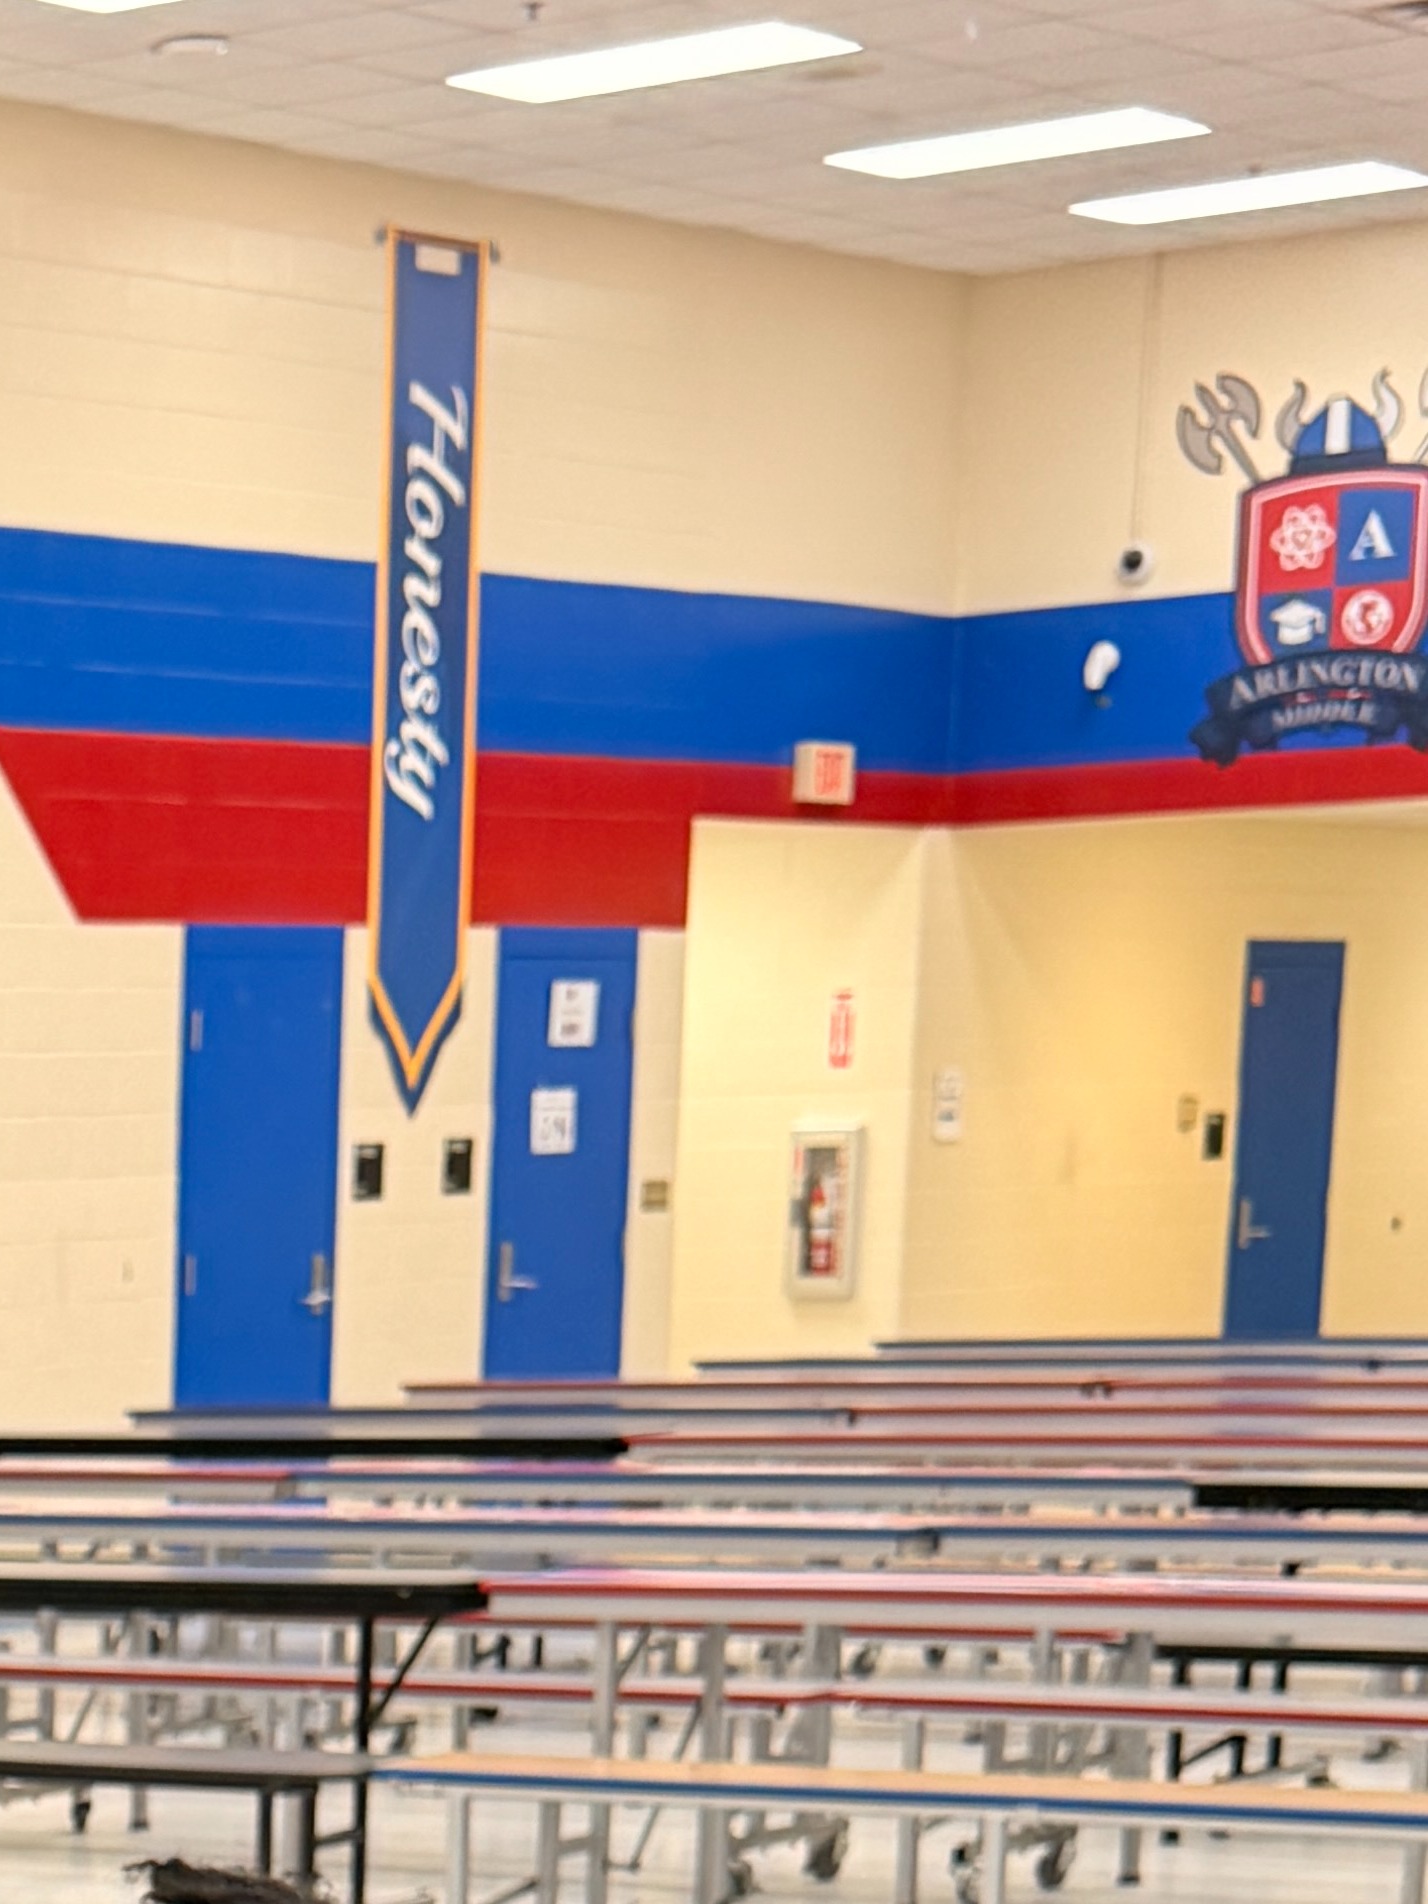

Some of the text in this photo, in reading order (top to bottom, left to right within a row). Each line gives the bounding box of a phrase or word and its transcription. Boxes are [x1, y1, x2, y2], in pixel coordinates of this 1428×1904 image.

[1348, 508, 1398, 562] A
[382, 380, 469, 821] Honesty
[1229, 654, 1421, 711] ARLINGTON
